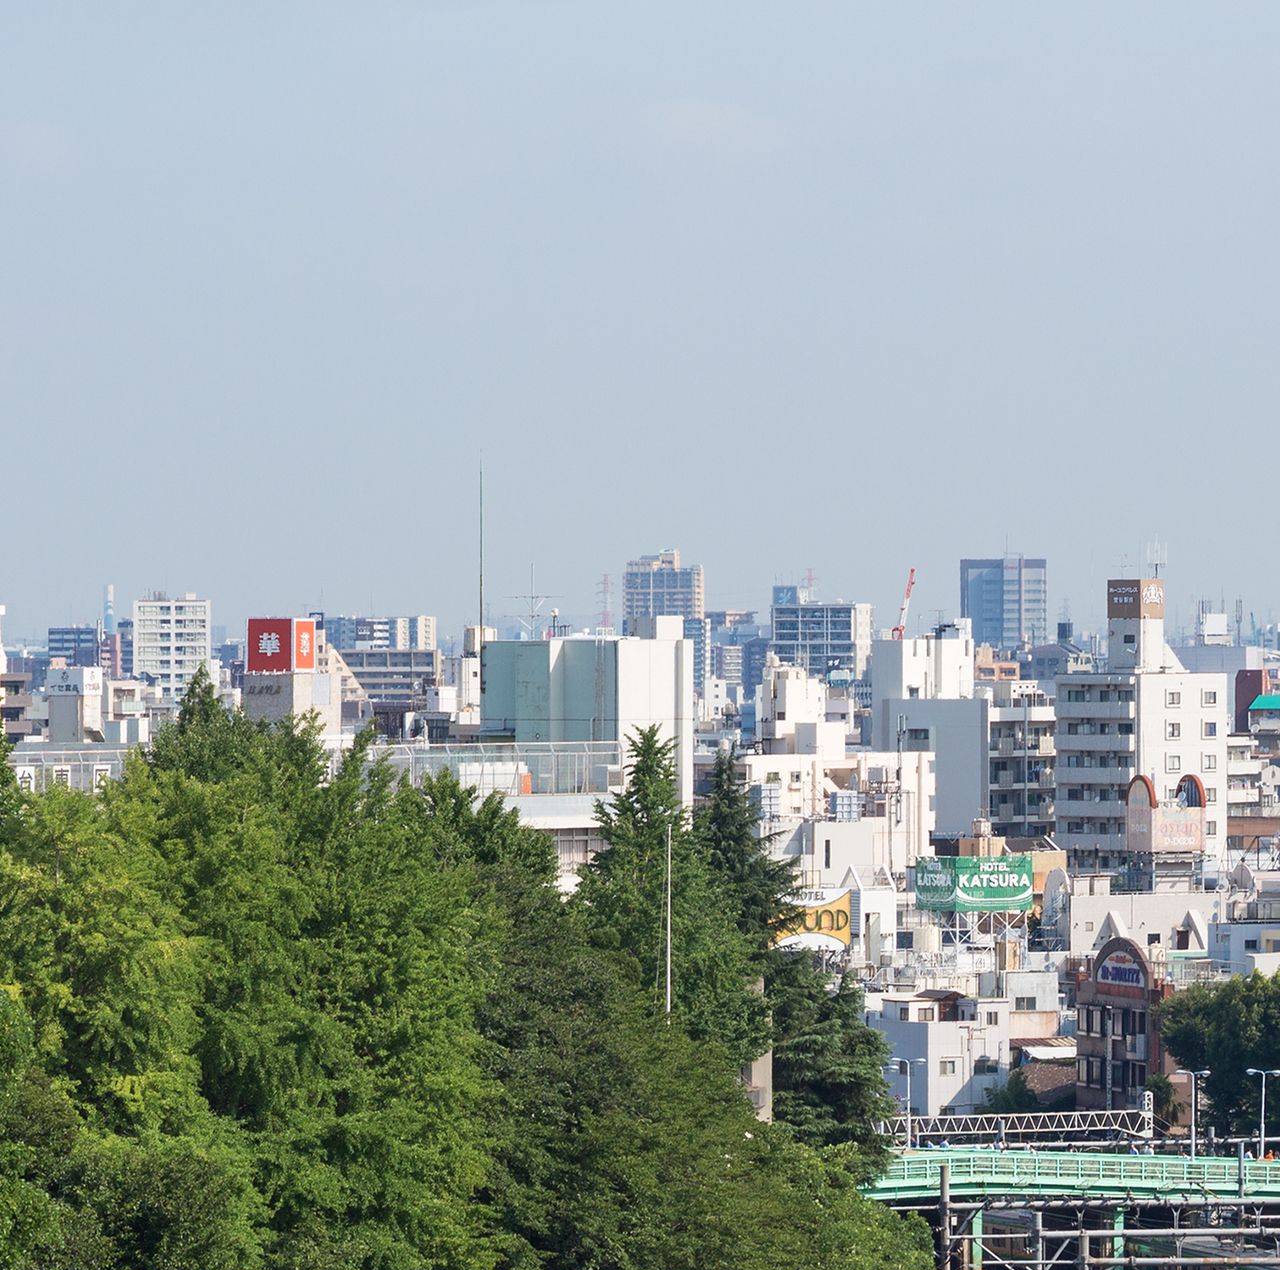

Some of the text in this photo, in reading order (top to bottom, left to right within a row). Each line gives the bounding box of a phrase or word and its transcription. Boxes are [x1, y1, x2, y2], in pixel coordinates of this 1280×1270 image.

[258, 632, 281, 657] 華
[979, 862, 1010, 873] HOTEL
[917, 872, 953, 888] KATSURA
[958, 873, 1031, 888] KATSURA
